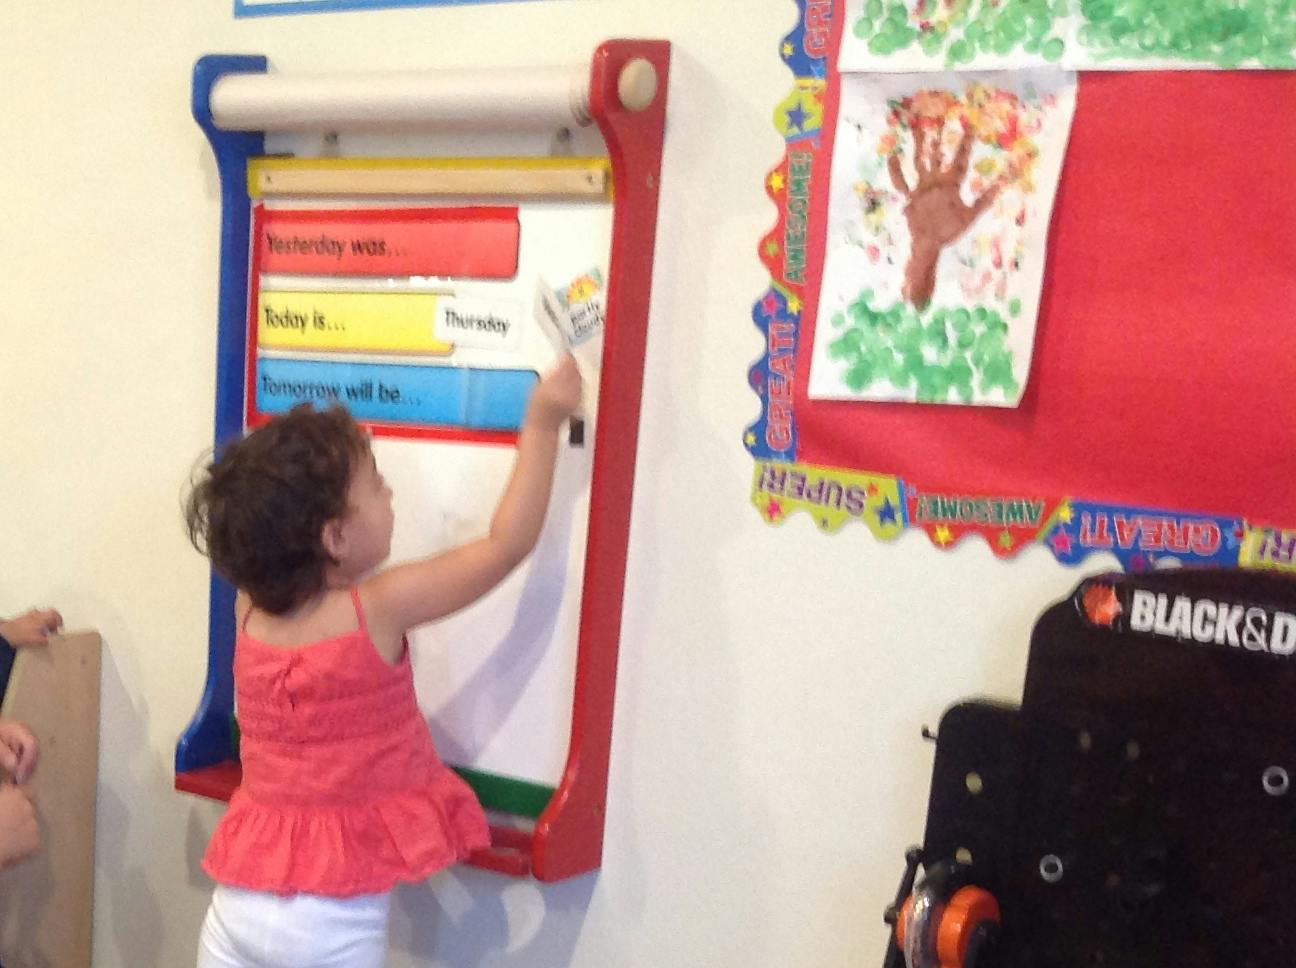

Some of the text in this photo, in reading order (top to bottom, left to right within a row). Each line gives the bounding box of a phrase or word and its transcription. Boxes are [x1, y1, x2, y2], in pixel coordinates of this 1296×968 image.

[784, 151, 812, 284] AWESOME!
[266, 233, 346, 260] Yesterday
[264, 307, 308, 334] Today
[444, 307, 510, 337] Thursday
[262, 375, 341, 400] Tomorrow
[345, 380, 374, 401] will
[766, 320, 795, 451] GREAT!
[758, 465, 867, 516] SUPER!
[916, 496, 1046, 527] AWESOME!
[1079, 511, 1223, 557] GREAT!
